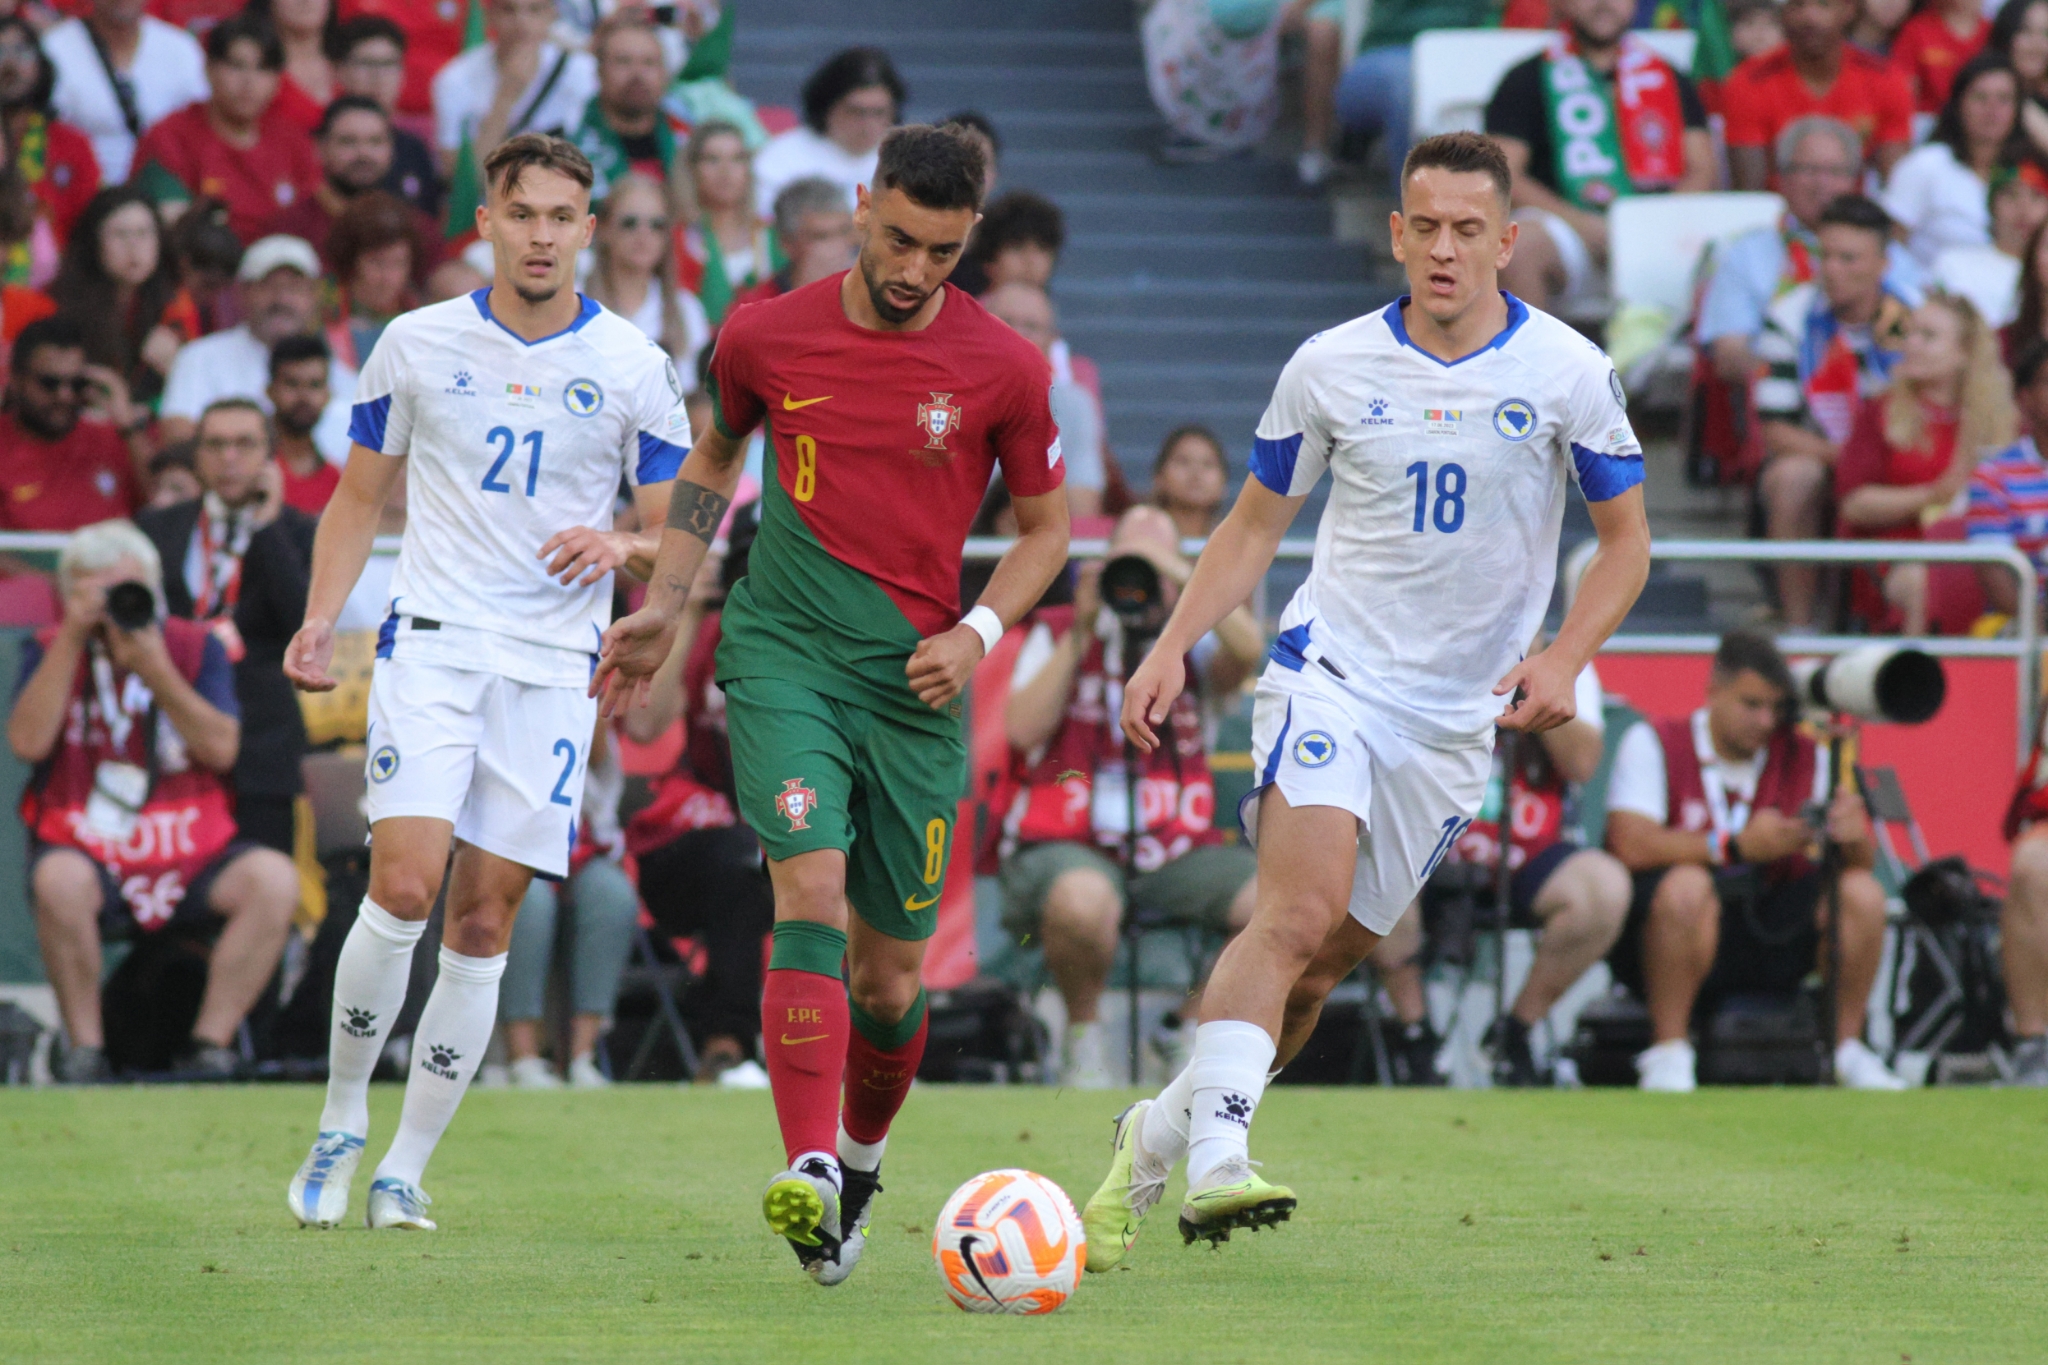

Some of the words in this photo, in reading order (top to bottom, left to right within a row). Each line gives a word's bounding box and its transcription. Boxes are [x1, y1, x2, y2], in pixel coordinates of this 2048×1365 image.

[445, 387, 477, 397] KELME
[1360, 417, 1394, 425] KELME
[481, 425, 544, 497] 21
[794, 434, 816, 502] 8
[1406, 461, 1467, 534] 18
[550, 738, 587, 807] 2
[923, 818, 946, 885] 8
[341, 1021, 378, 1038] KELME
[420, 1059, 459, 1081] KELME
